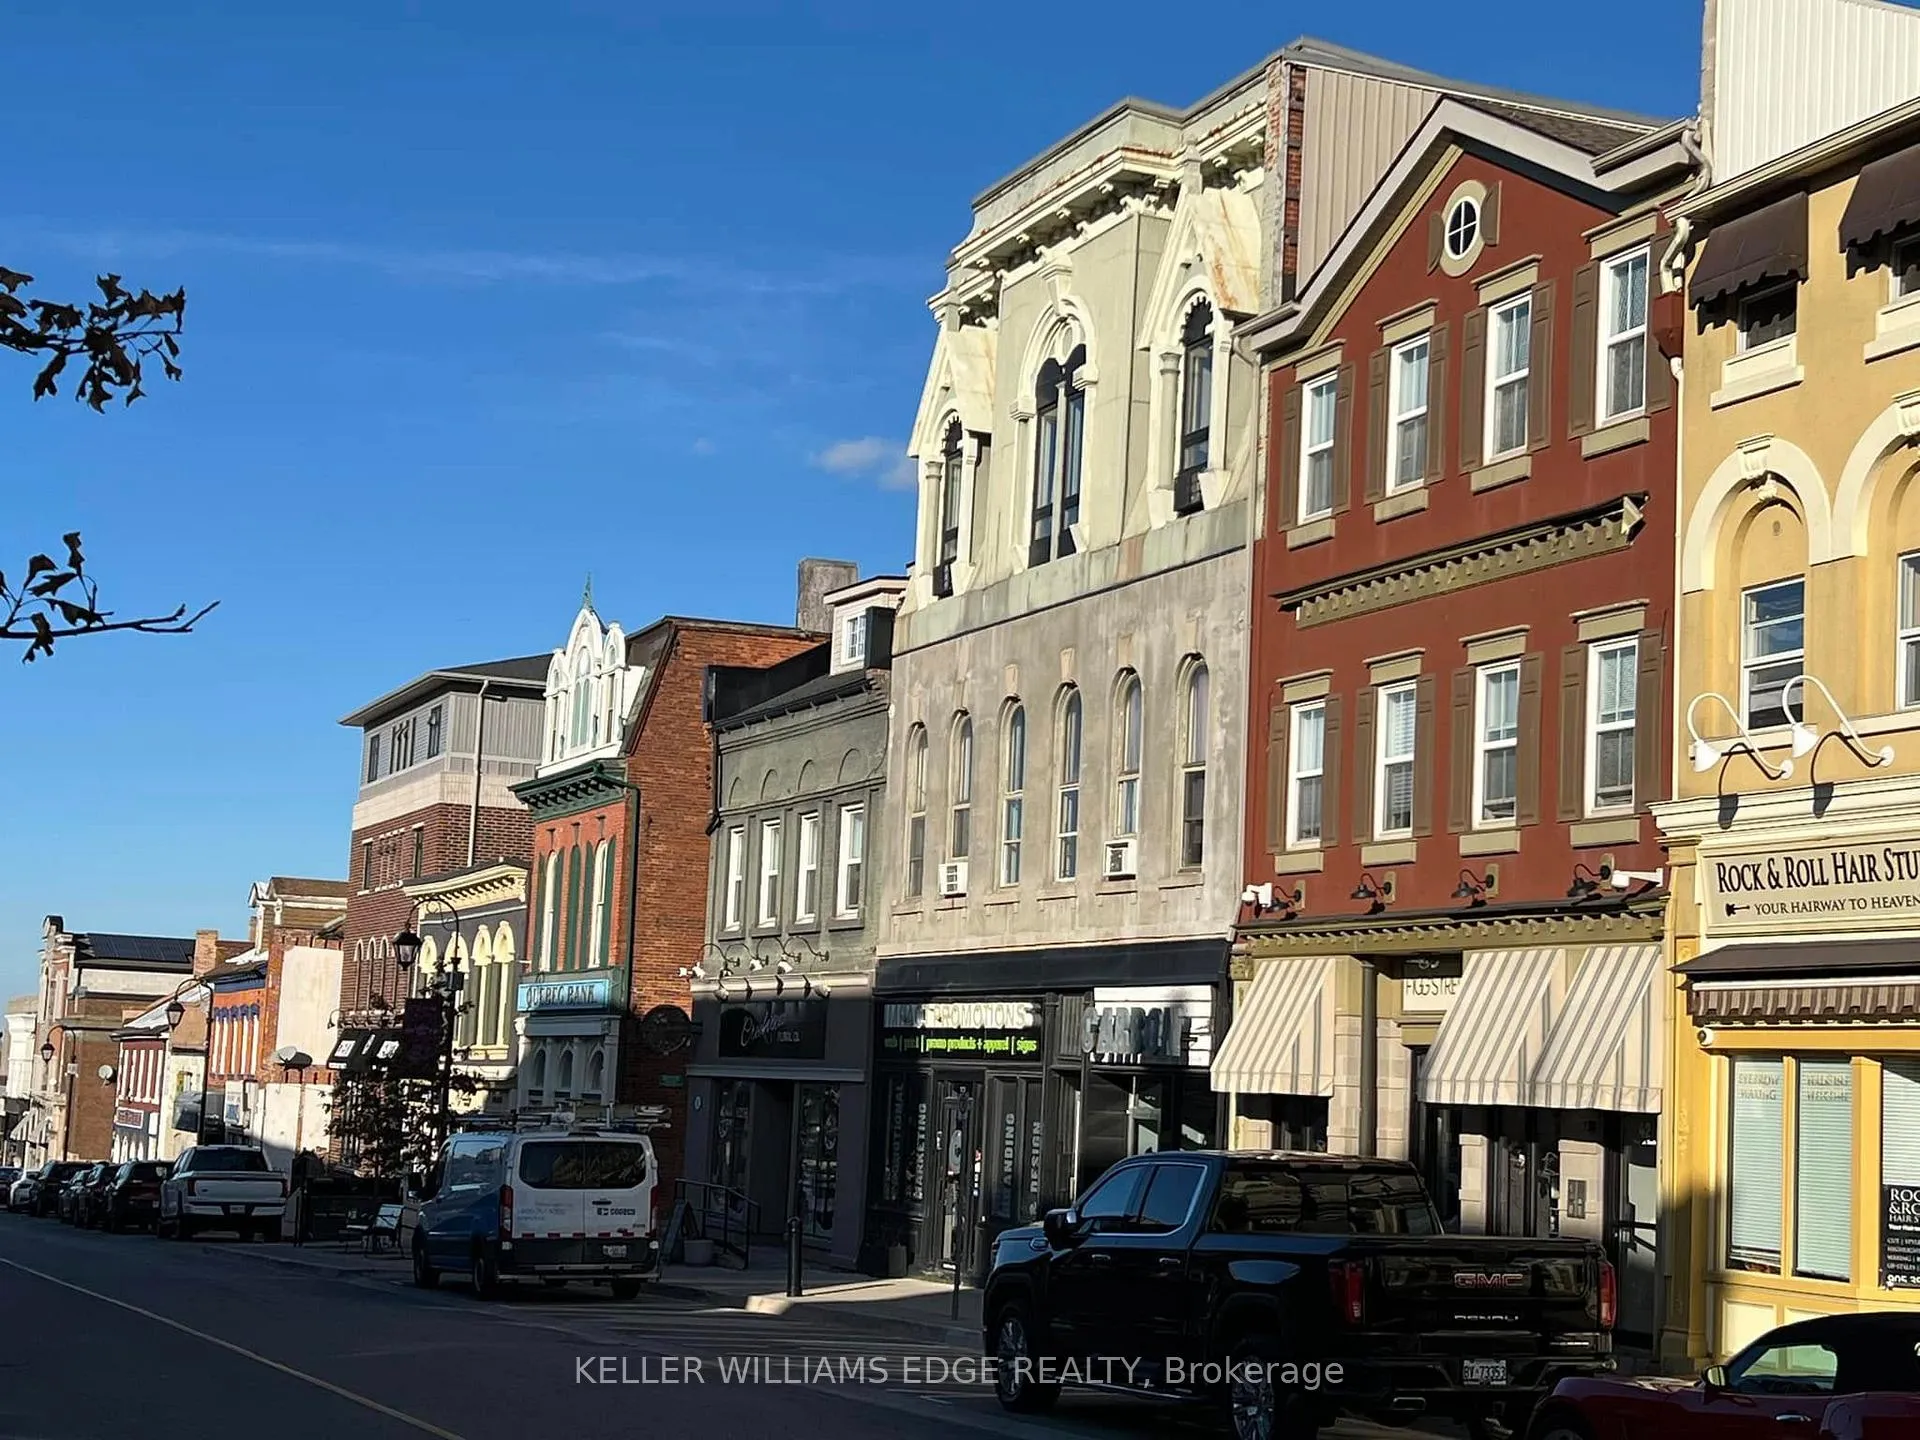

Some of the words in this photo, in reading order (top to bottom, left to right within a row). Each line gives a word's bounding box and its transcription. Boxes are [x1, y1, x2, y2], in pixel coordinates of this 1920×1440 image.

[1715, 862, 1766, 893] ROCK
[1767, 857, 1784, 890] &
[1783, 856, 1829, 888] ROLL
[1831, 851, 1882, 885] HAIR
[1754, 902, 1789, 915] YOUR
[1791, 898, 1847, 914] HAIRWAY
[1848, 897, 1868, 910] TO
[567, 983, 598, 1007] BANK
[933, 1002, 1030, 1029] PROMOTIONS
[1015, 1036, 1038, 1053] signs
[913, 1103, 927, 1200] MARKETING
[1889, 1214, 1912, 1223] HAIR
[1454, 1273, 1524, 1288] GMC
